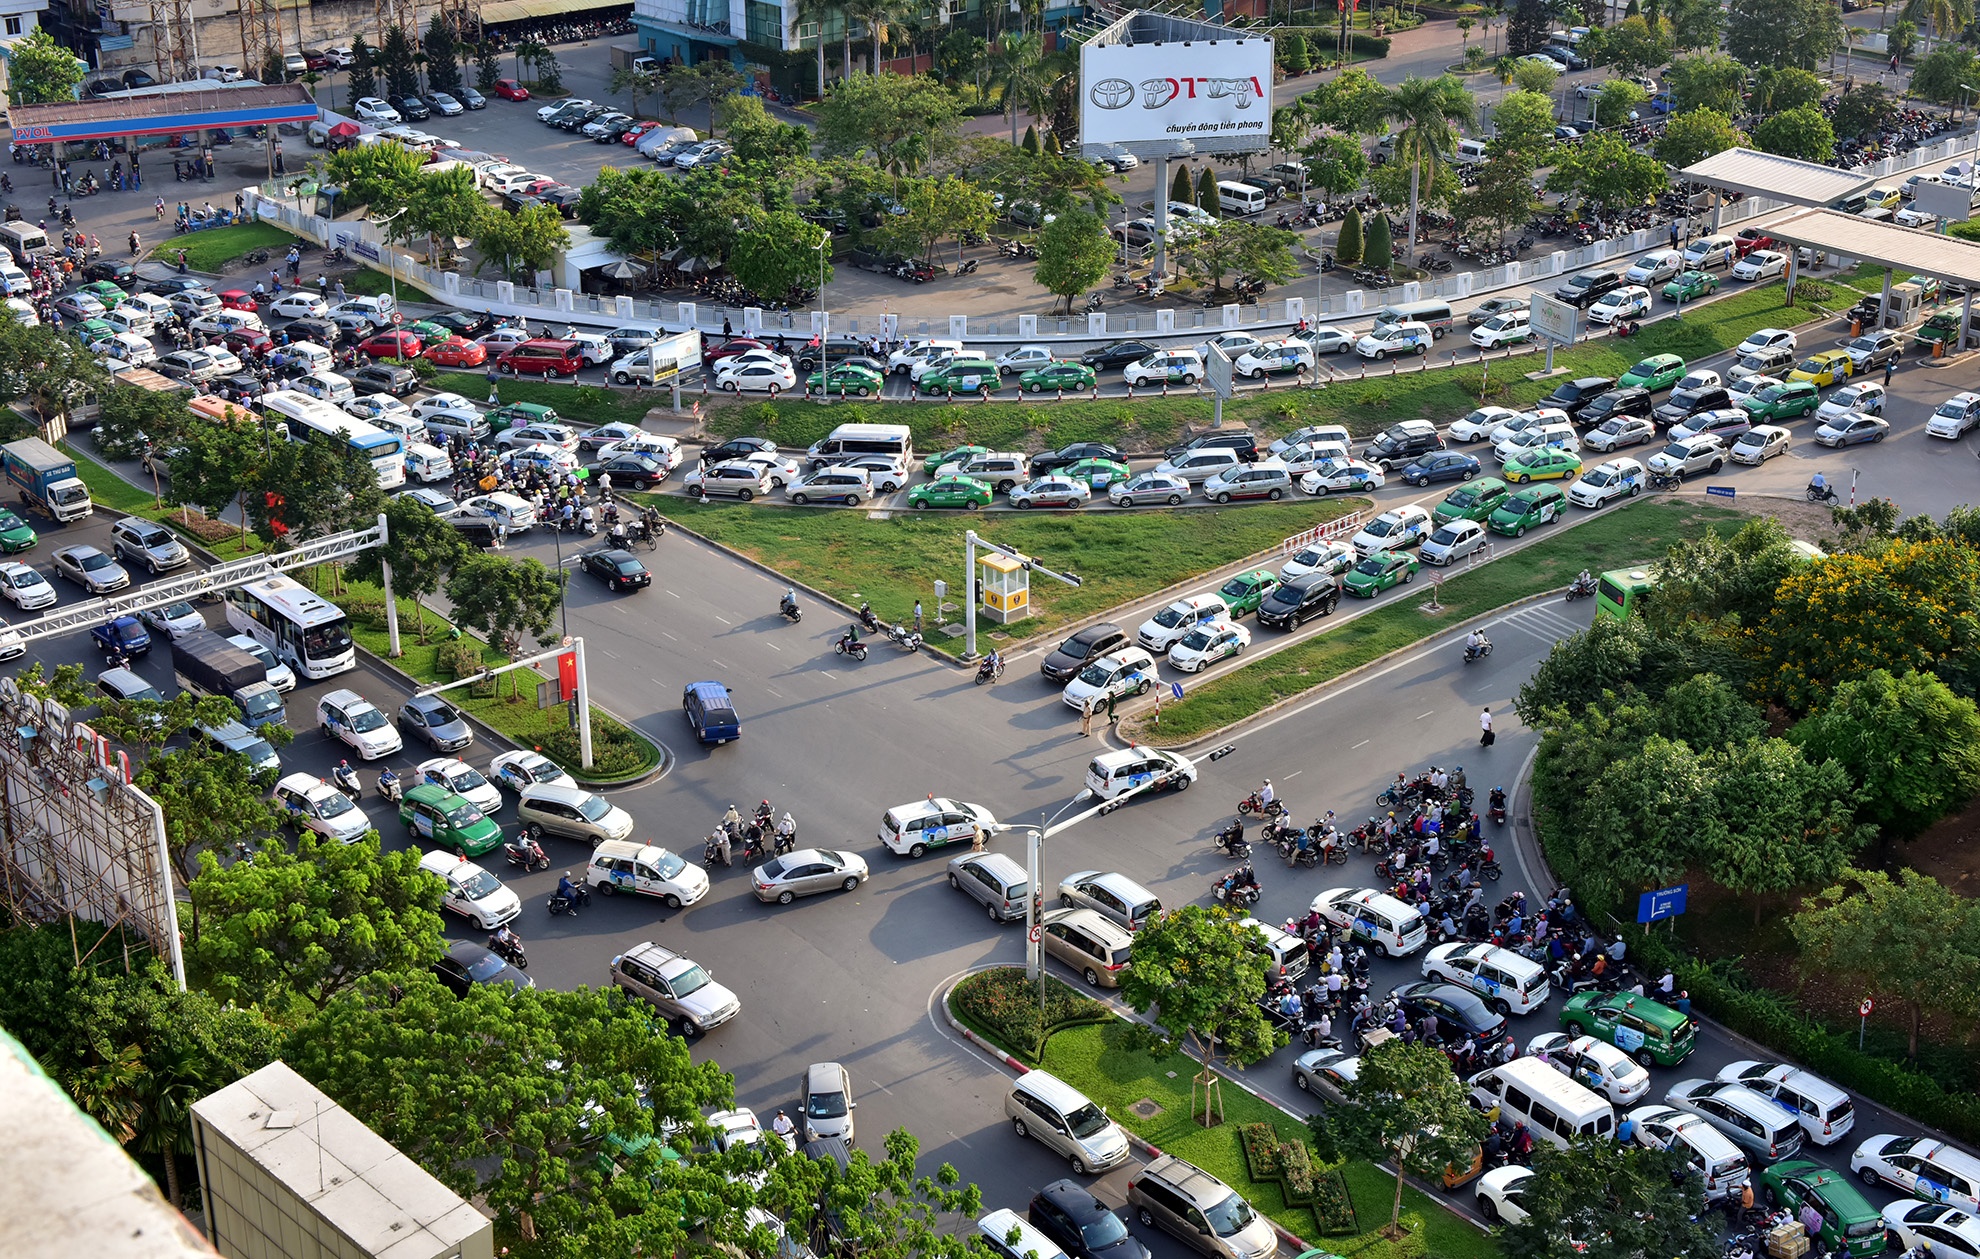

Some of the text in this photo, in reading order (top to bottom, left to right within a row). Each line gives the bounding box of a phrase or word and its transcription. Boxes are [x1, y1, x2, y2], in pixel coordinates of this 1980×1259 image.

[1237, 120, 1263, 130] phong
[16, 127, 52, 139] PV OIL
